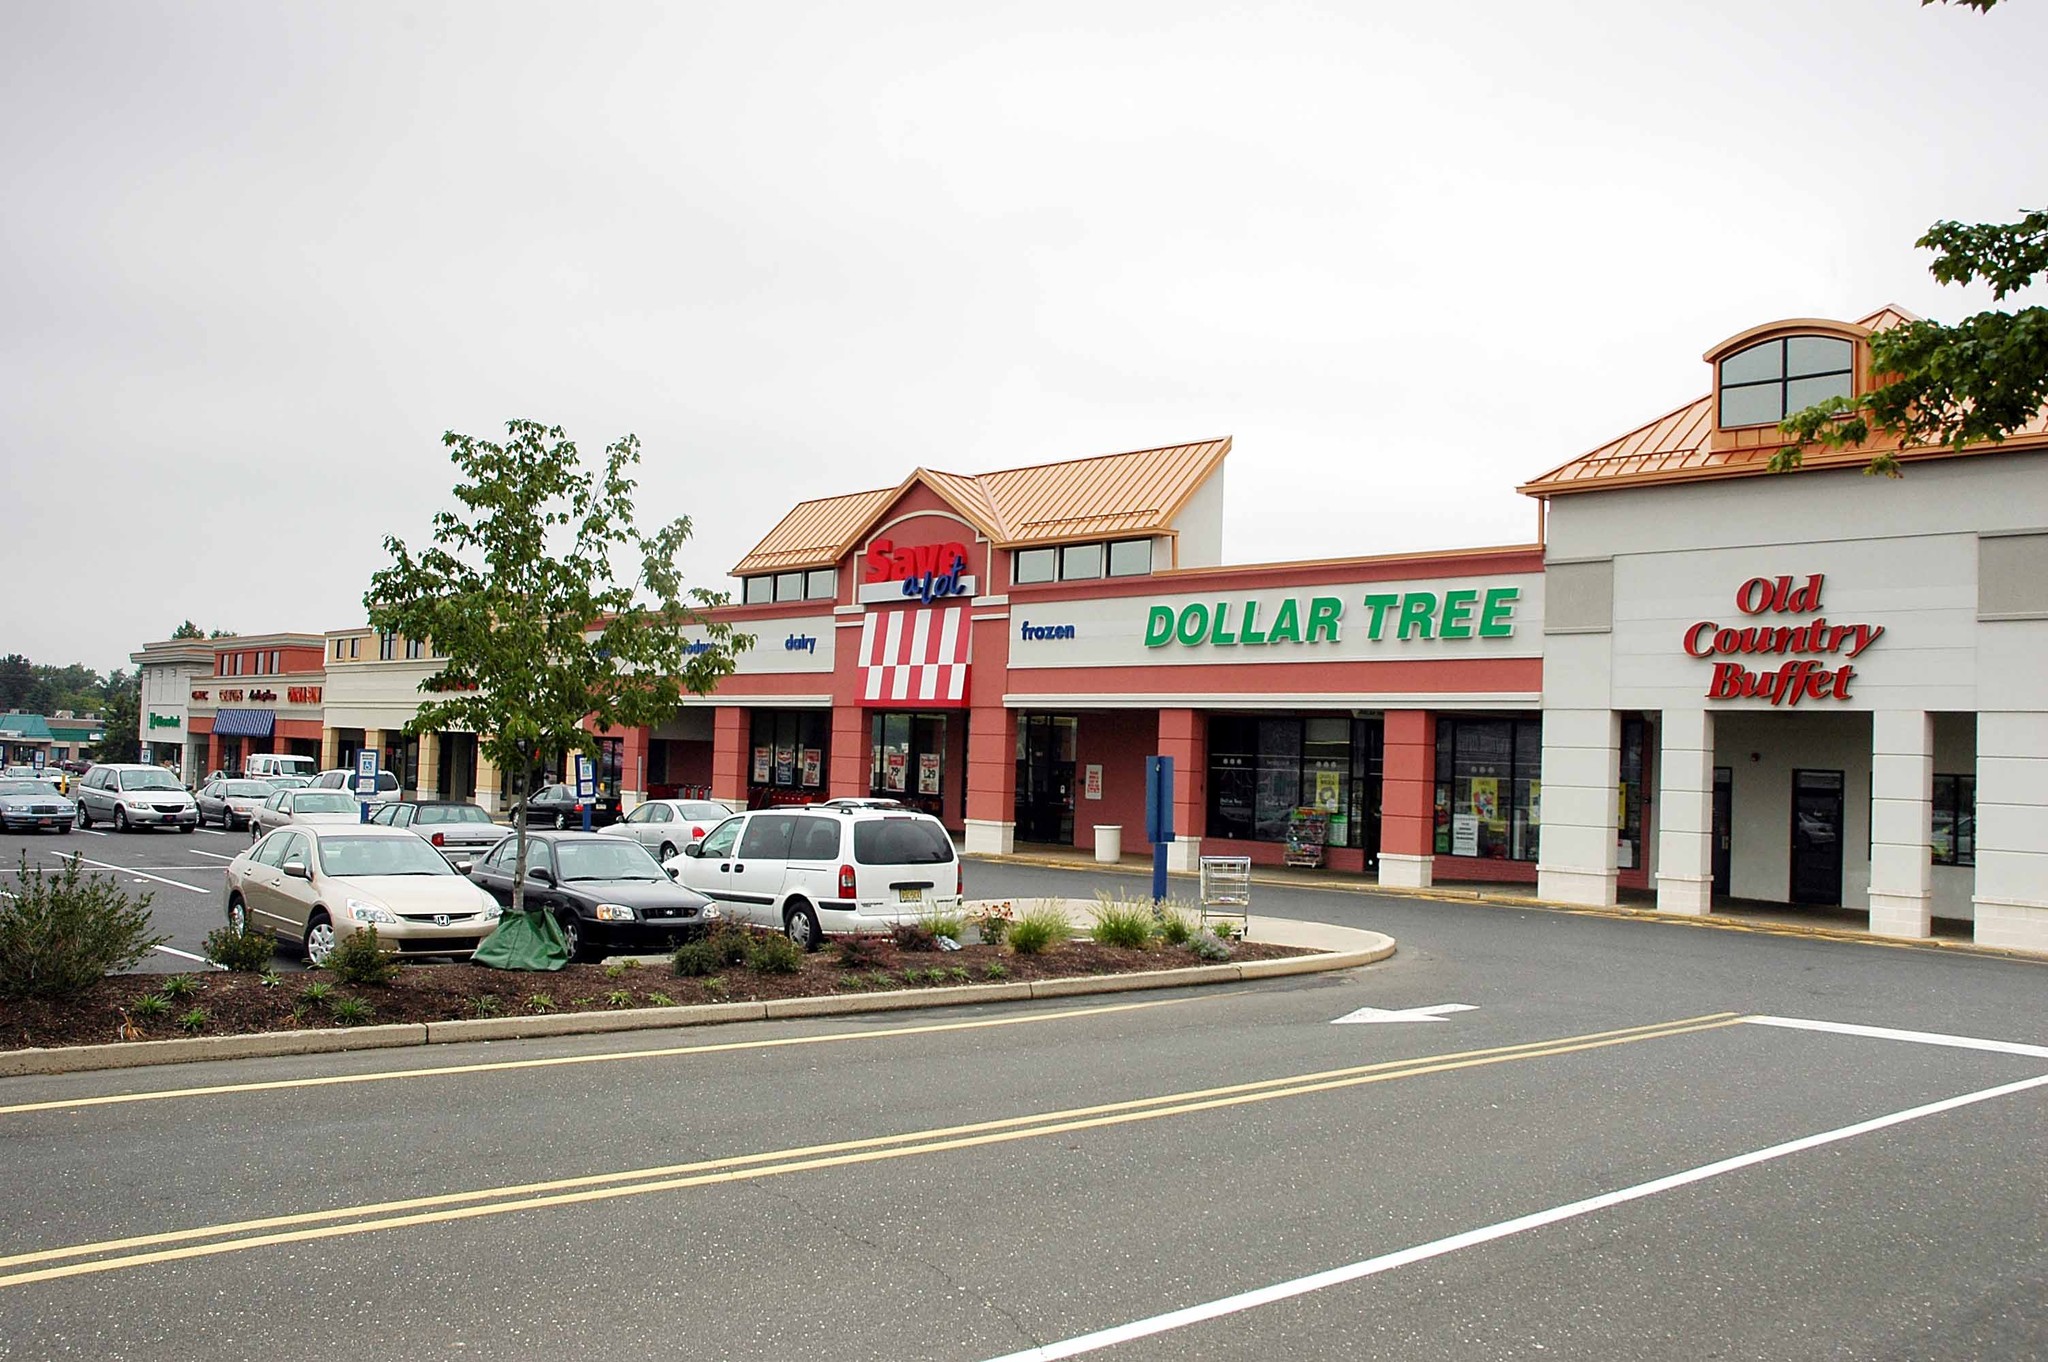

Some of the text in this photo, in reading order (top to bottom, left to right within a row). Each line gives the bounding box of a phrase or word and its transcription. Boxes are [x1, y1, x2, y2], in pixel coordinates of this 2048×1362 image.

[866, 538, 968, 583] Save
[1736, 573, 1825, 615] Old
[1021, 620, 1075, 640] frozen
[1144, 587, 1521, 648] DOLLAR TREE
[1683, 617, 1885, 659] Country
[785, 633, 817, 655] dairy
[1704, 659, 1858, 706] Buffet
